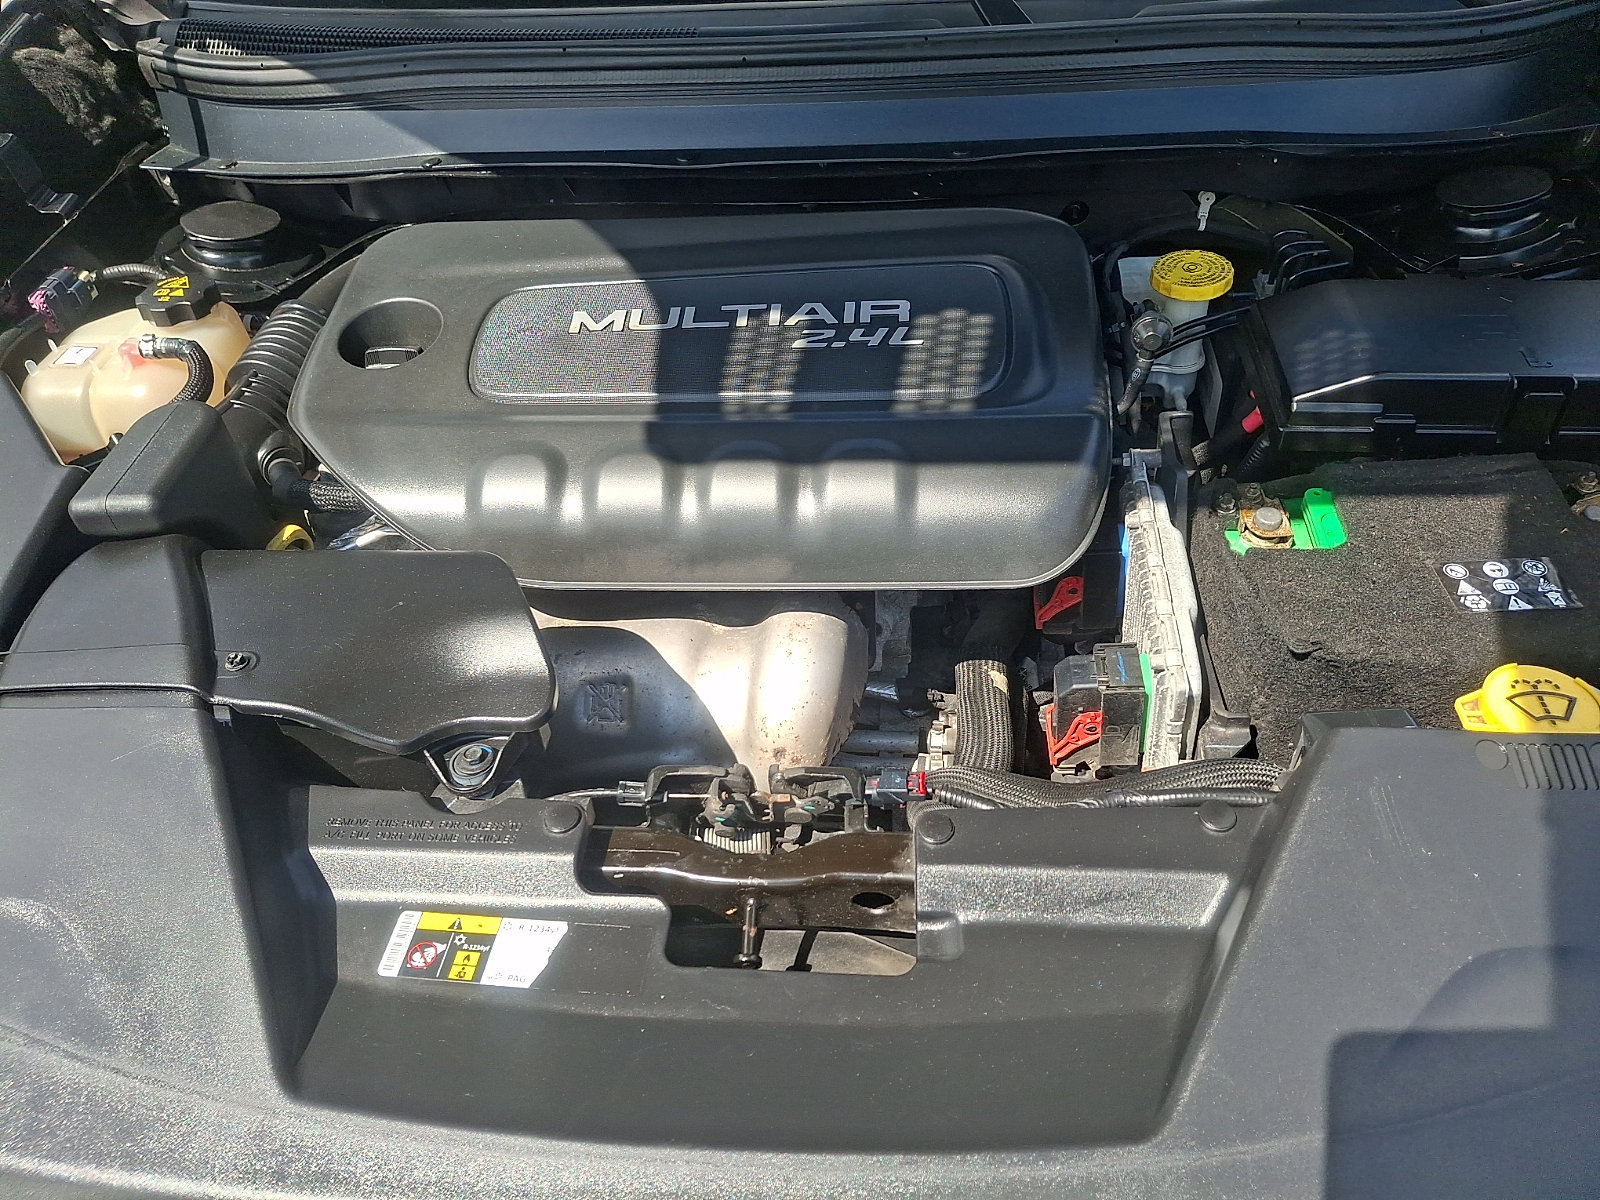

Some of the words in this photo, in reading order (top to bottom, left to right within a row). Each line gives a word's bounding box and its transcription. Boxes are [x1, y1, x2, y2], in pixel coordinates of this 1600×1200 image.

[567, 299, 912, 334] MULTIAIR
[790, 326, 925, 349] 2.4L
[325, 817, 373, 828] REMOVE
[374, 818, 401, 829] THIS
[401, 819, 435, 830] PANEL
[438, 820, 462, 830] FOR
[463, 820, 507, 831] ACCESS
[508, 820, 523, 831] TO
[322, 828, 346, 840] A/C
[348, 830, 371, 841] FILL
[374, 831, 406, 842] PORT
[408, 832, 426, 843] ON
[427, 832, 460, 844] SOME
[463, 833, 518, 845] VEHICLES
